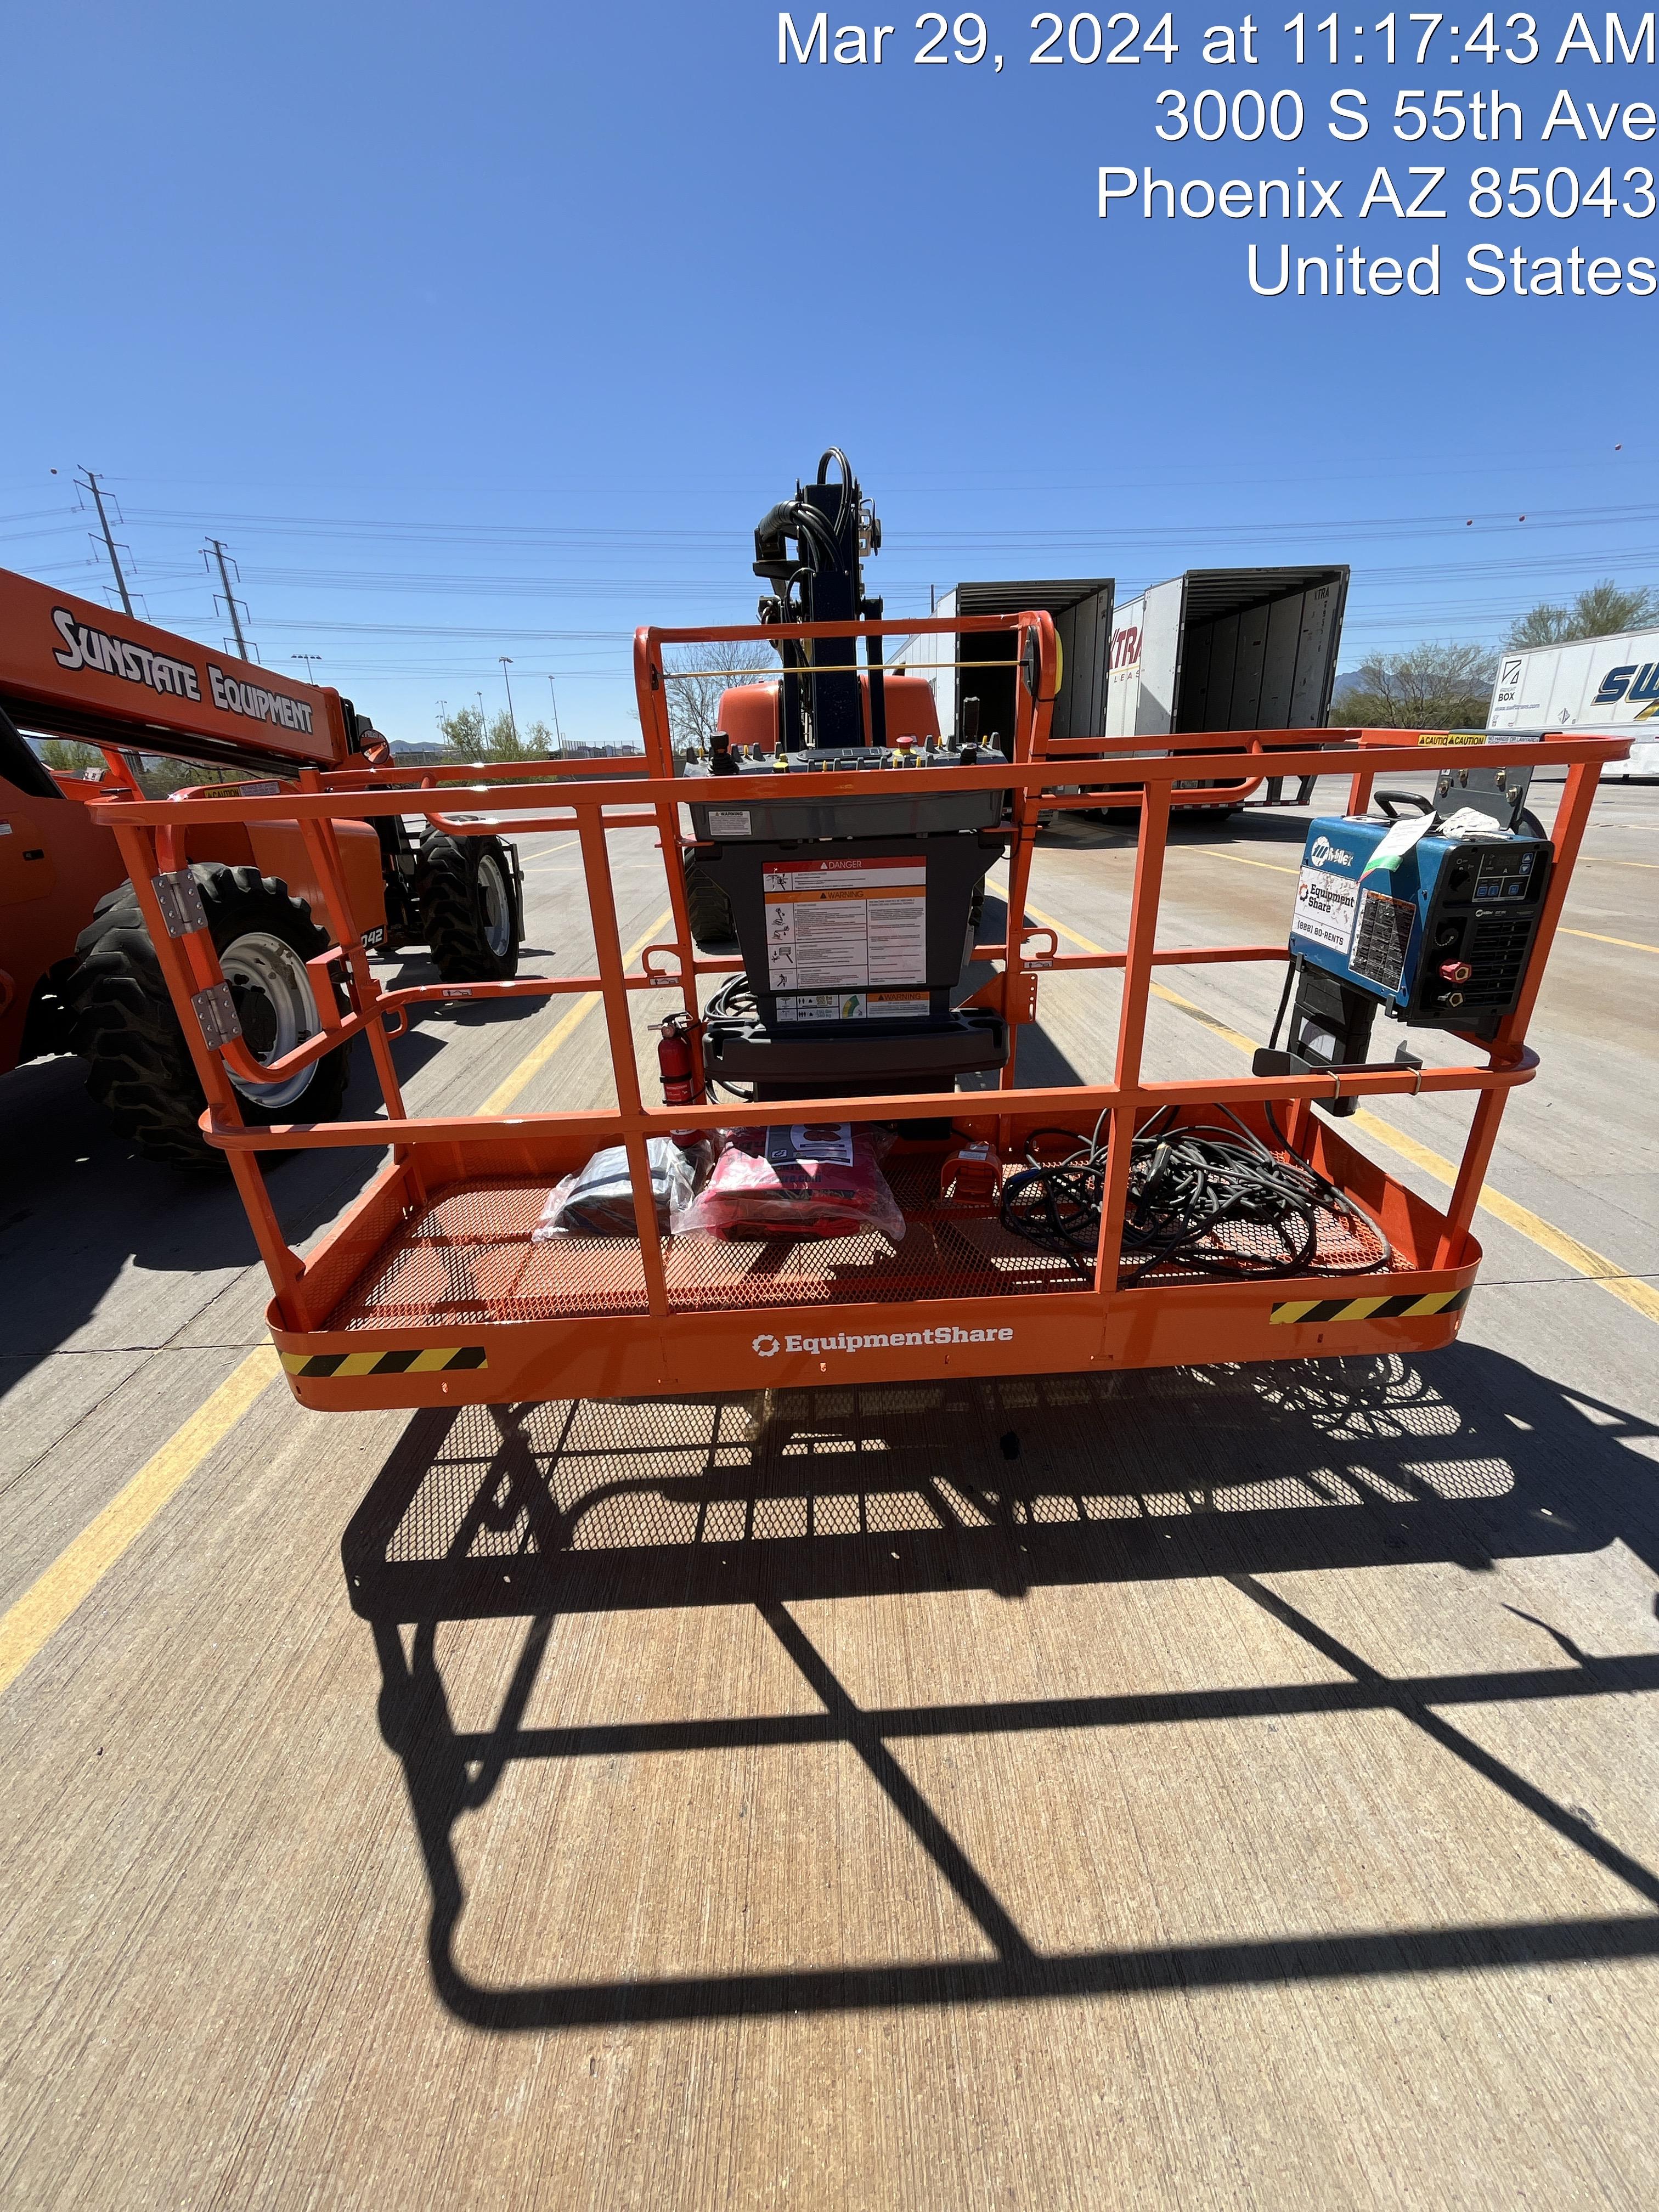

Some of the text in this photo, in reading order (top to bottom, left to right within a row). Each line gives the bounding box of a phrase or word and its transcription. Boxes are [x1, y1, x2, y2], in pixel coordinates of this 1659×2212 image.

[53, 607, 313, 734] SUNSTATE EQUIPMENT
[1498, 692, 1515, 702] BOX
[1425, 737, 1448, 745] CAUTIO
[1454, 737, 1483, 745] CAUTION
[212, 789, 239, 798] CAUTION
[828, 860, 862, 869] DANGER
[828, 890, 864, 899] WARNING
[1310, 883, 1355, 908] Equipment
[1308, 896, 1331, 913] Share
[884, 992, 921, 1001] WARNING
[785, 1327, 1014, 1354] EquipmentShare
